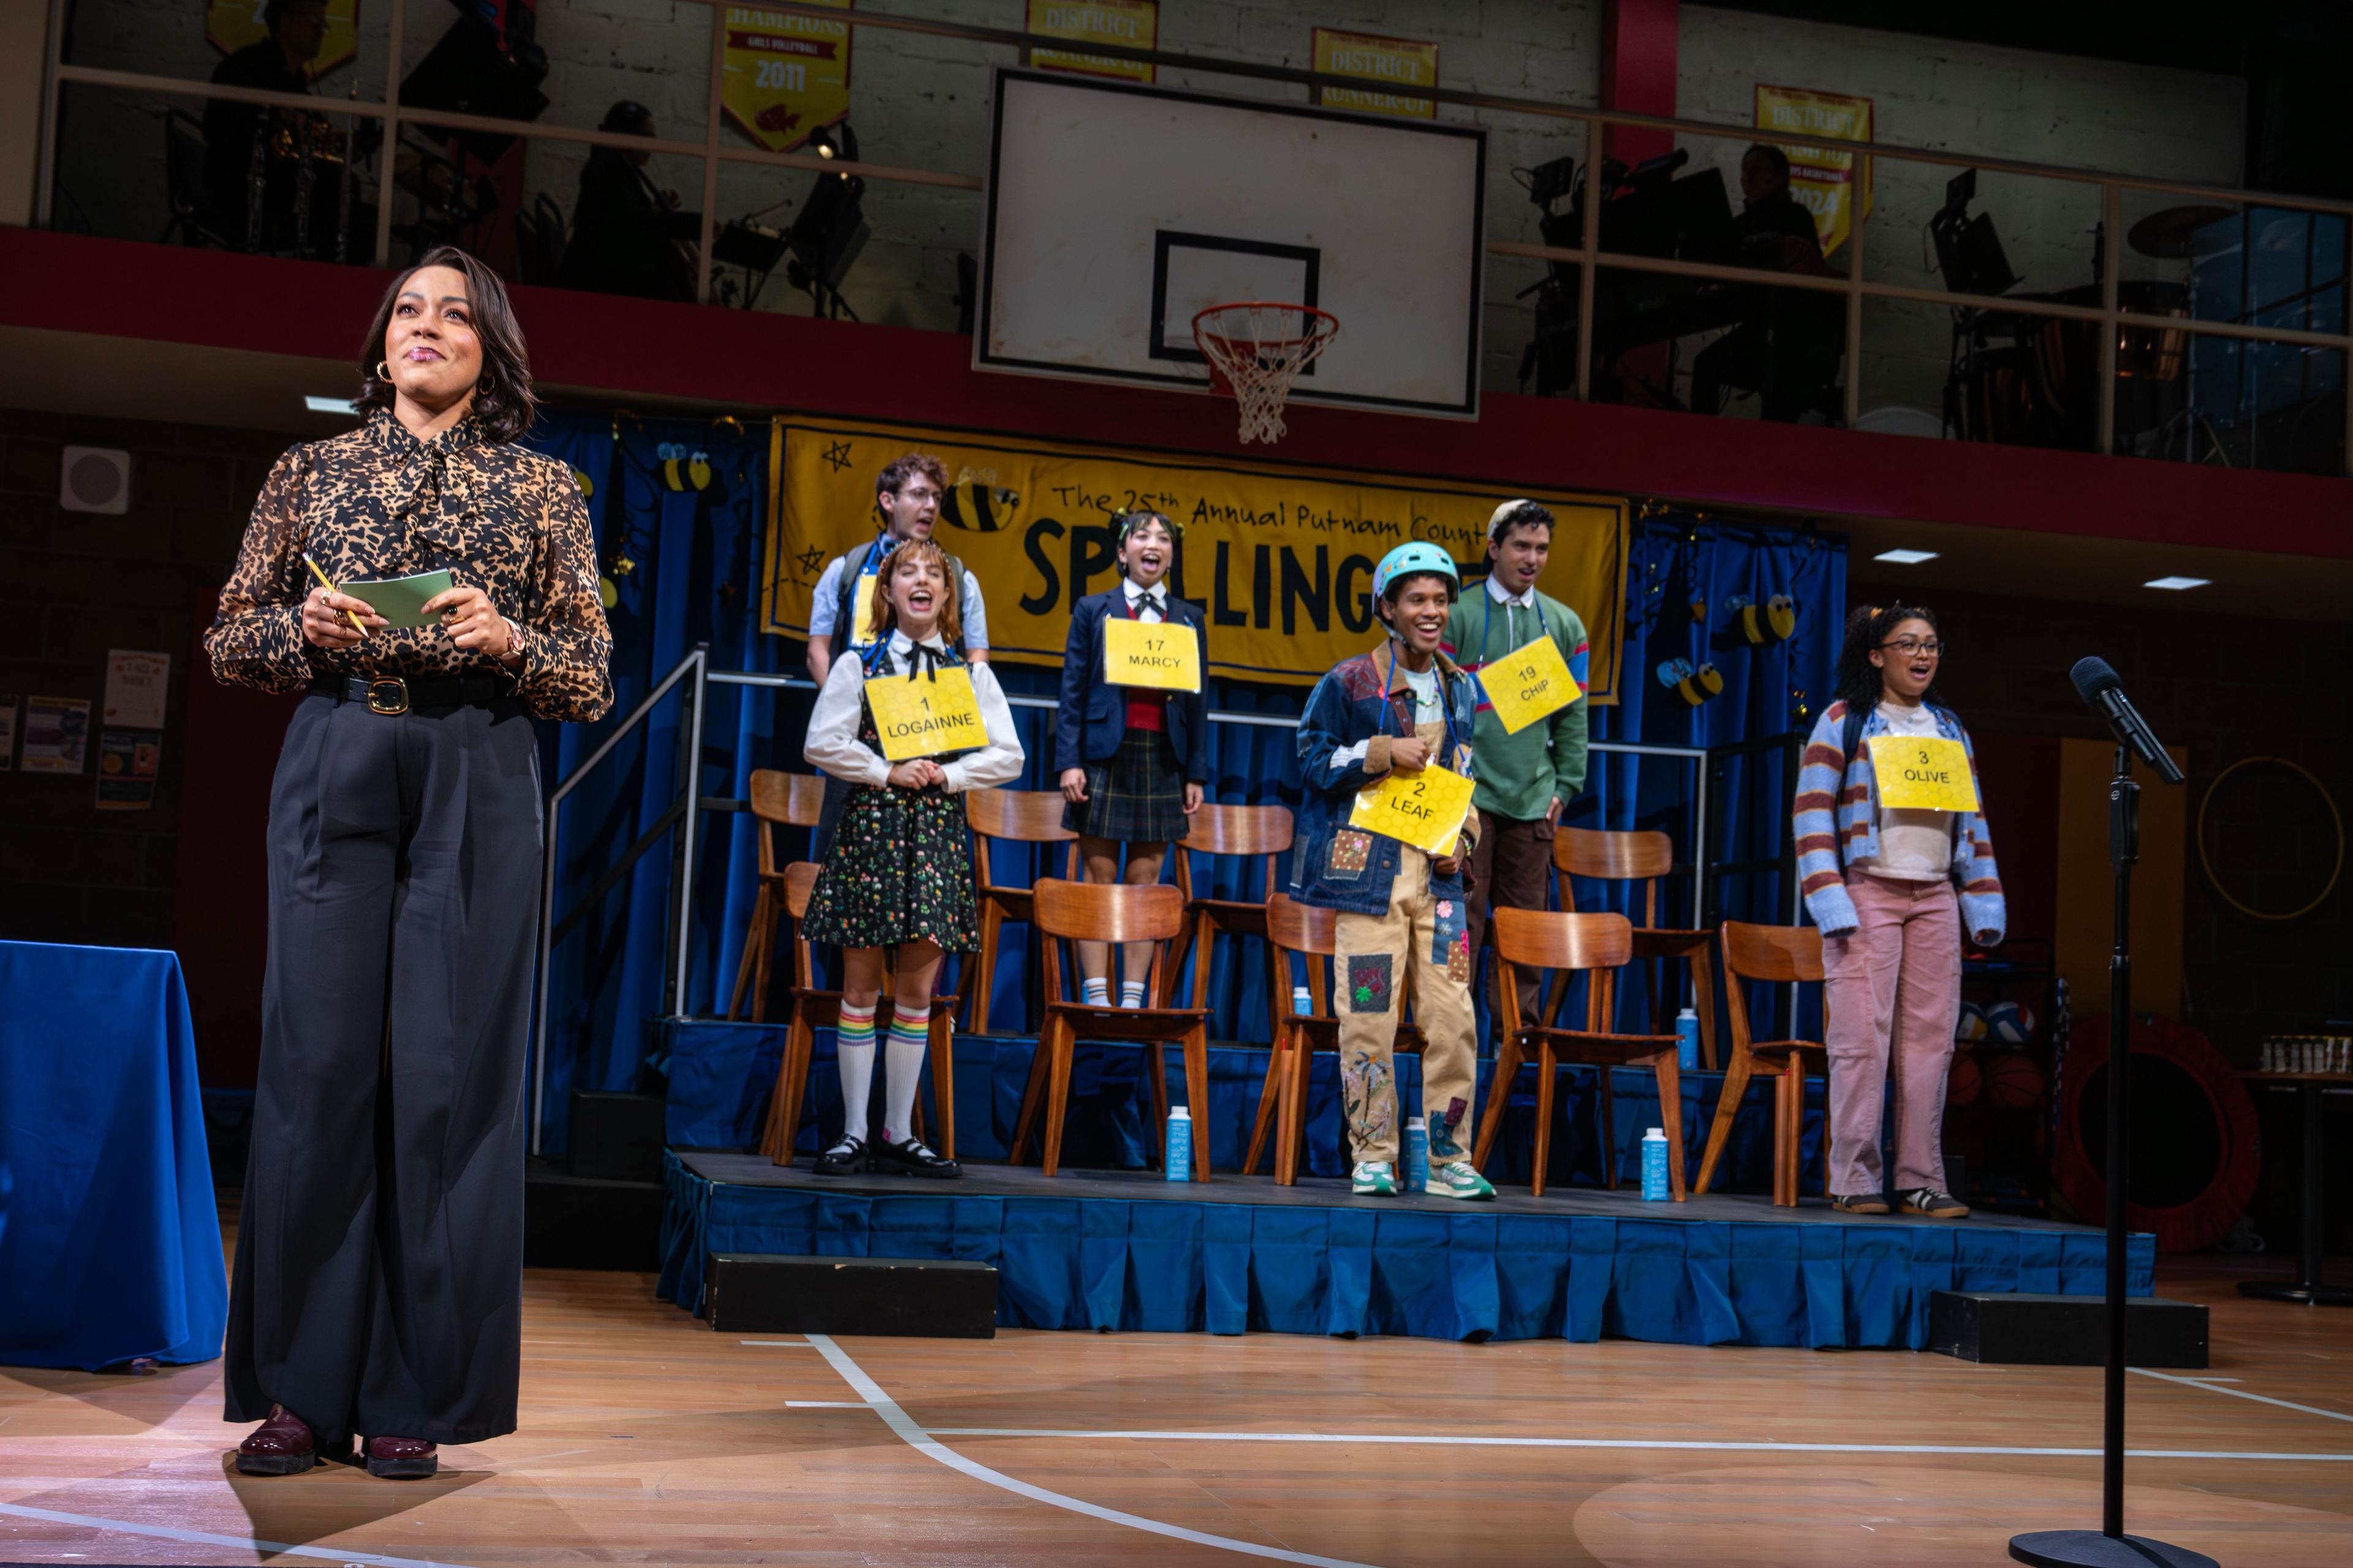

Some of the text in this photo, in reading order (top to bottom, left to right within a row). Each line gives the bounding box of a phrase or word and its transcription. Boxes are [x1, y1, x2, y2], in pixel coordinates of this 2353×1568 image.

[1045, 8, 1138, 40] DISTRICT
[771, 38, 818, 55] VOLLEYBALL
[754, 58, 806, 93] 2011
[1330, 50, 1420, 81] DISTRICT
[1773, 106, 1855, 136] DISTRICT
[1052, 484, 1488, 545] The 25th Annual Putnam Count
[1018, 517, 1374, 635] SPLLING
[1146, 639, 1164, 651] 17
[1129, 655, 1181, 668] MARCY
[1519, 666, 1536, 682] 19
[1520, 679, 1548, 701] CHIP
[920, 697, 930, 711] 1
[887, 713, 975, 738] LOGAINNE
[1919, 751, 1929, 764] 3
[1904, 769, 1950, 784] OLIVE
[1413, 782, 1426, 797] 2
[1391, 796, 1434, 820] LEAF
